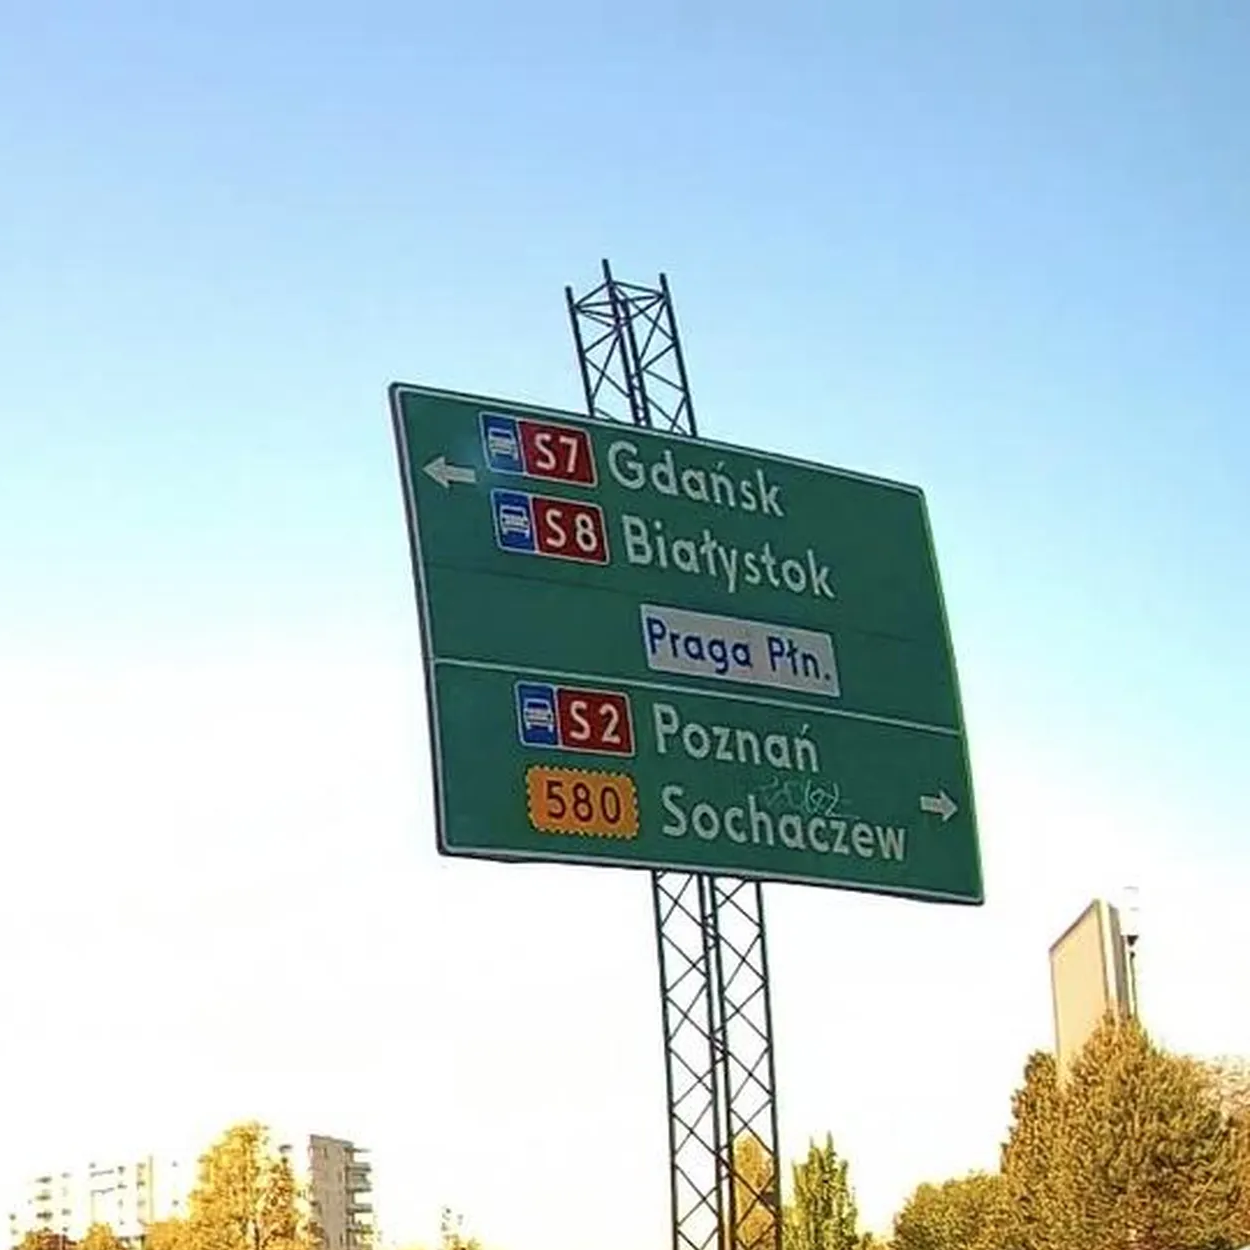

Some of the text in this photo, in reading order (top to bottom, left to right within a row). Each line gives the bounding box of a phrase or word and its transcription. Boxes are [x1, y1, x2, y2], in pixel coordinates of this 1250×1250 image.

[534, 432, 785, 517] S7 Gdańsk
[545, 508, 836, 598] S8 Białystok
[645, 618, 833, 682] Praga Płn.
[569, 700, 820, 773] S2 Poznań
[545, 780, 622, 825] 580
[662, 784, 908, 862] Sochaczew
